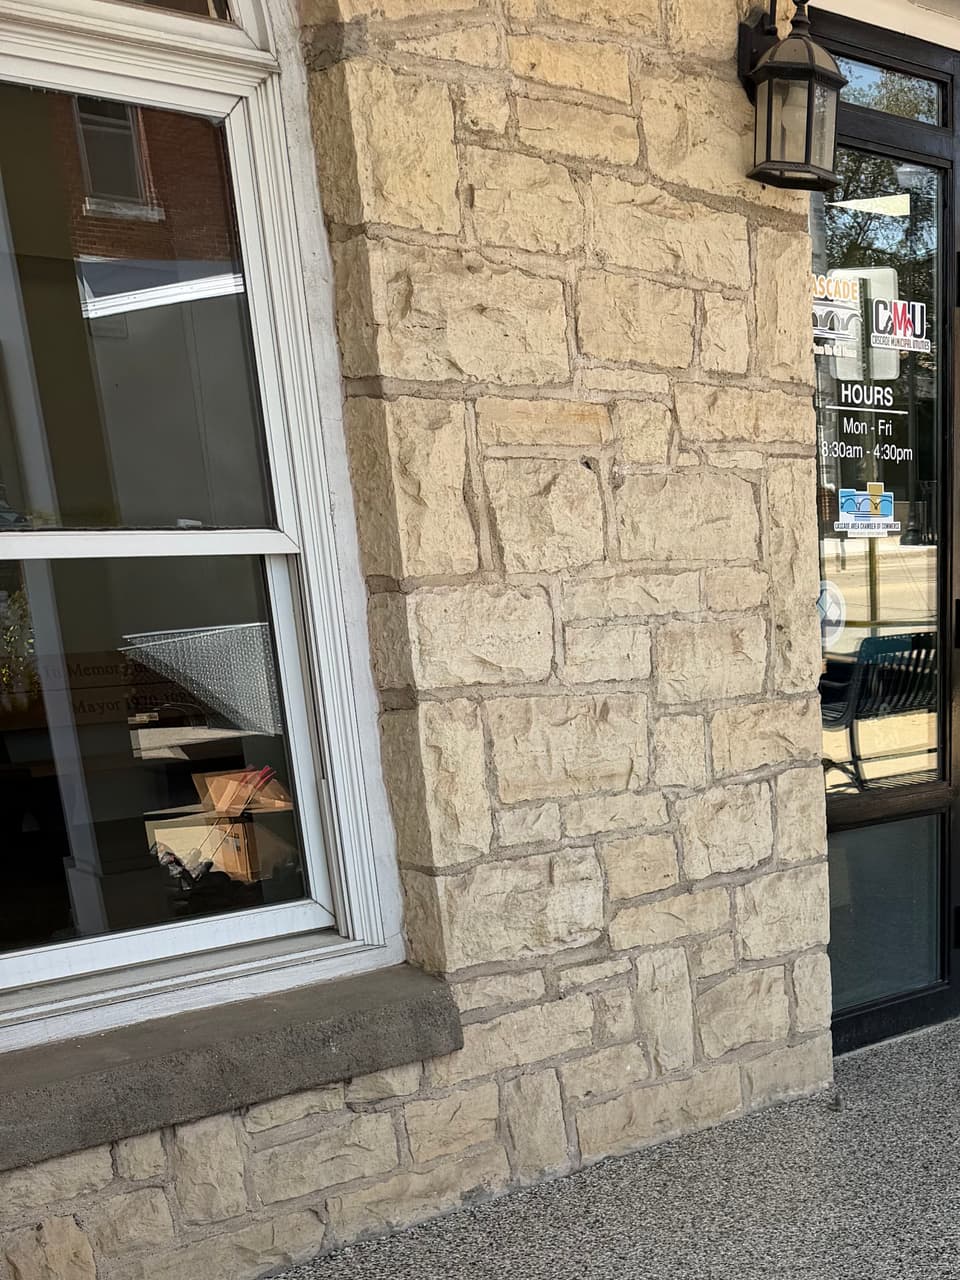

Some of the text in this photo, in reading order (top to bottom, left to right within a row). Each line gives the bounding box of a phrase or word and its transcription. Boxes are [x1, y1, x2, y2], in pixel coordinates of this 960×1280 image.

[811, 275, 858, 300] ASCADE
[874, 299, 925, 340] CMU
[841, 383, 893, 407] HOURS
[843, 416, 868, 435] Mon
[878, 419, 892, 436] Fri
[821, 440, 863, 459] 8:30am
[873, 443, 913, 464] 4:30pm
